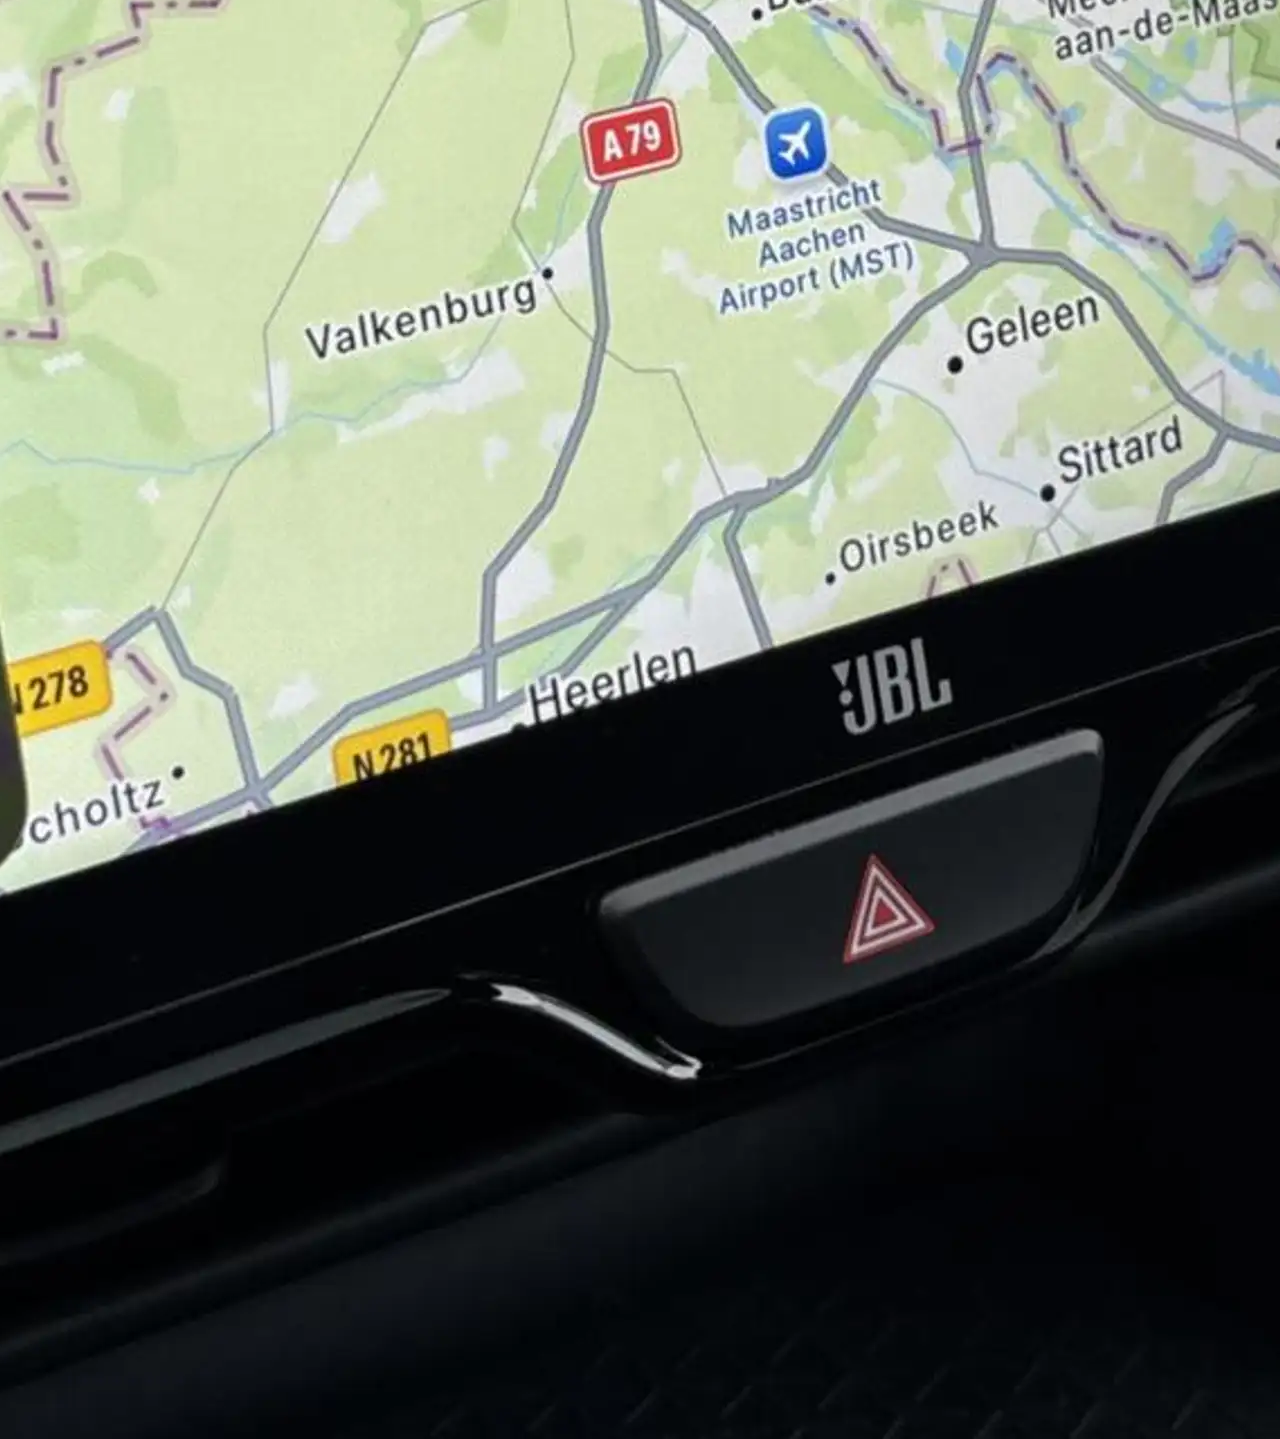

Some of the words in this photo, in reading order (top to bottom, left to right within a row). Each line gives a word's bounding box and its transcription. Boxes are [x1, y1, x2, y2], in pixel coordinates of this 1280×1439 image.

[727, 178, 882, 241] Maastricht
[757, 217, 866, 268] Aachen
[718, 265, 820, 317] Airport
[829, 238, 915, 292] (MST)
[304, 272, 538, 360] Valkenburg
[965, 293, 1100, 356] Geleen
[1057, 413, 1184, 485] Sittard
[838, 498, 1000, 574] Oirsbeek
[528, 645, 697, 725] Heerlen
[831, 636, 953, 737] JBL
[19, 779, 166, 846] choltz
